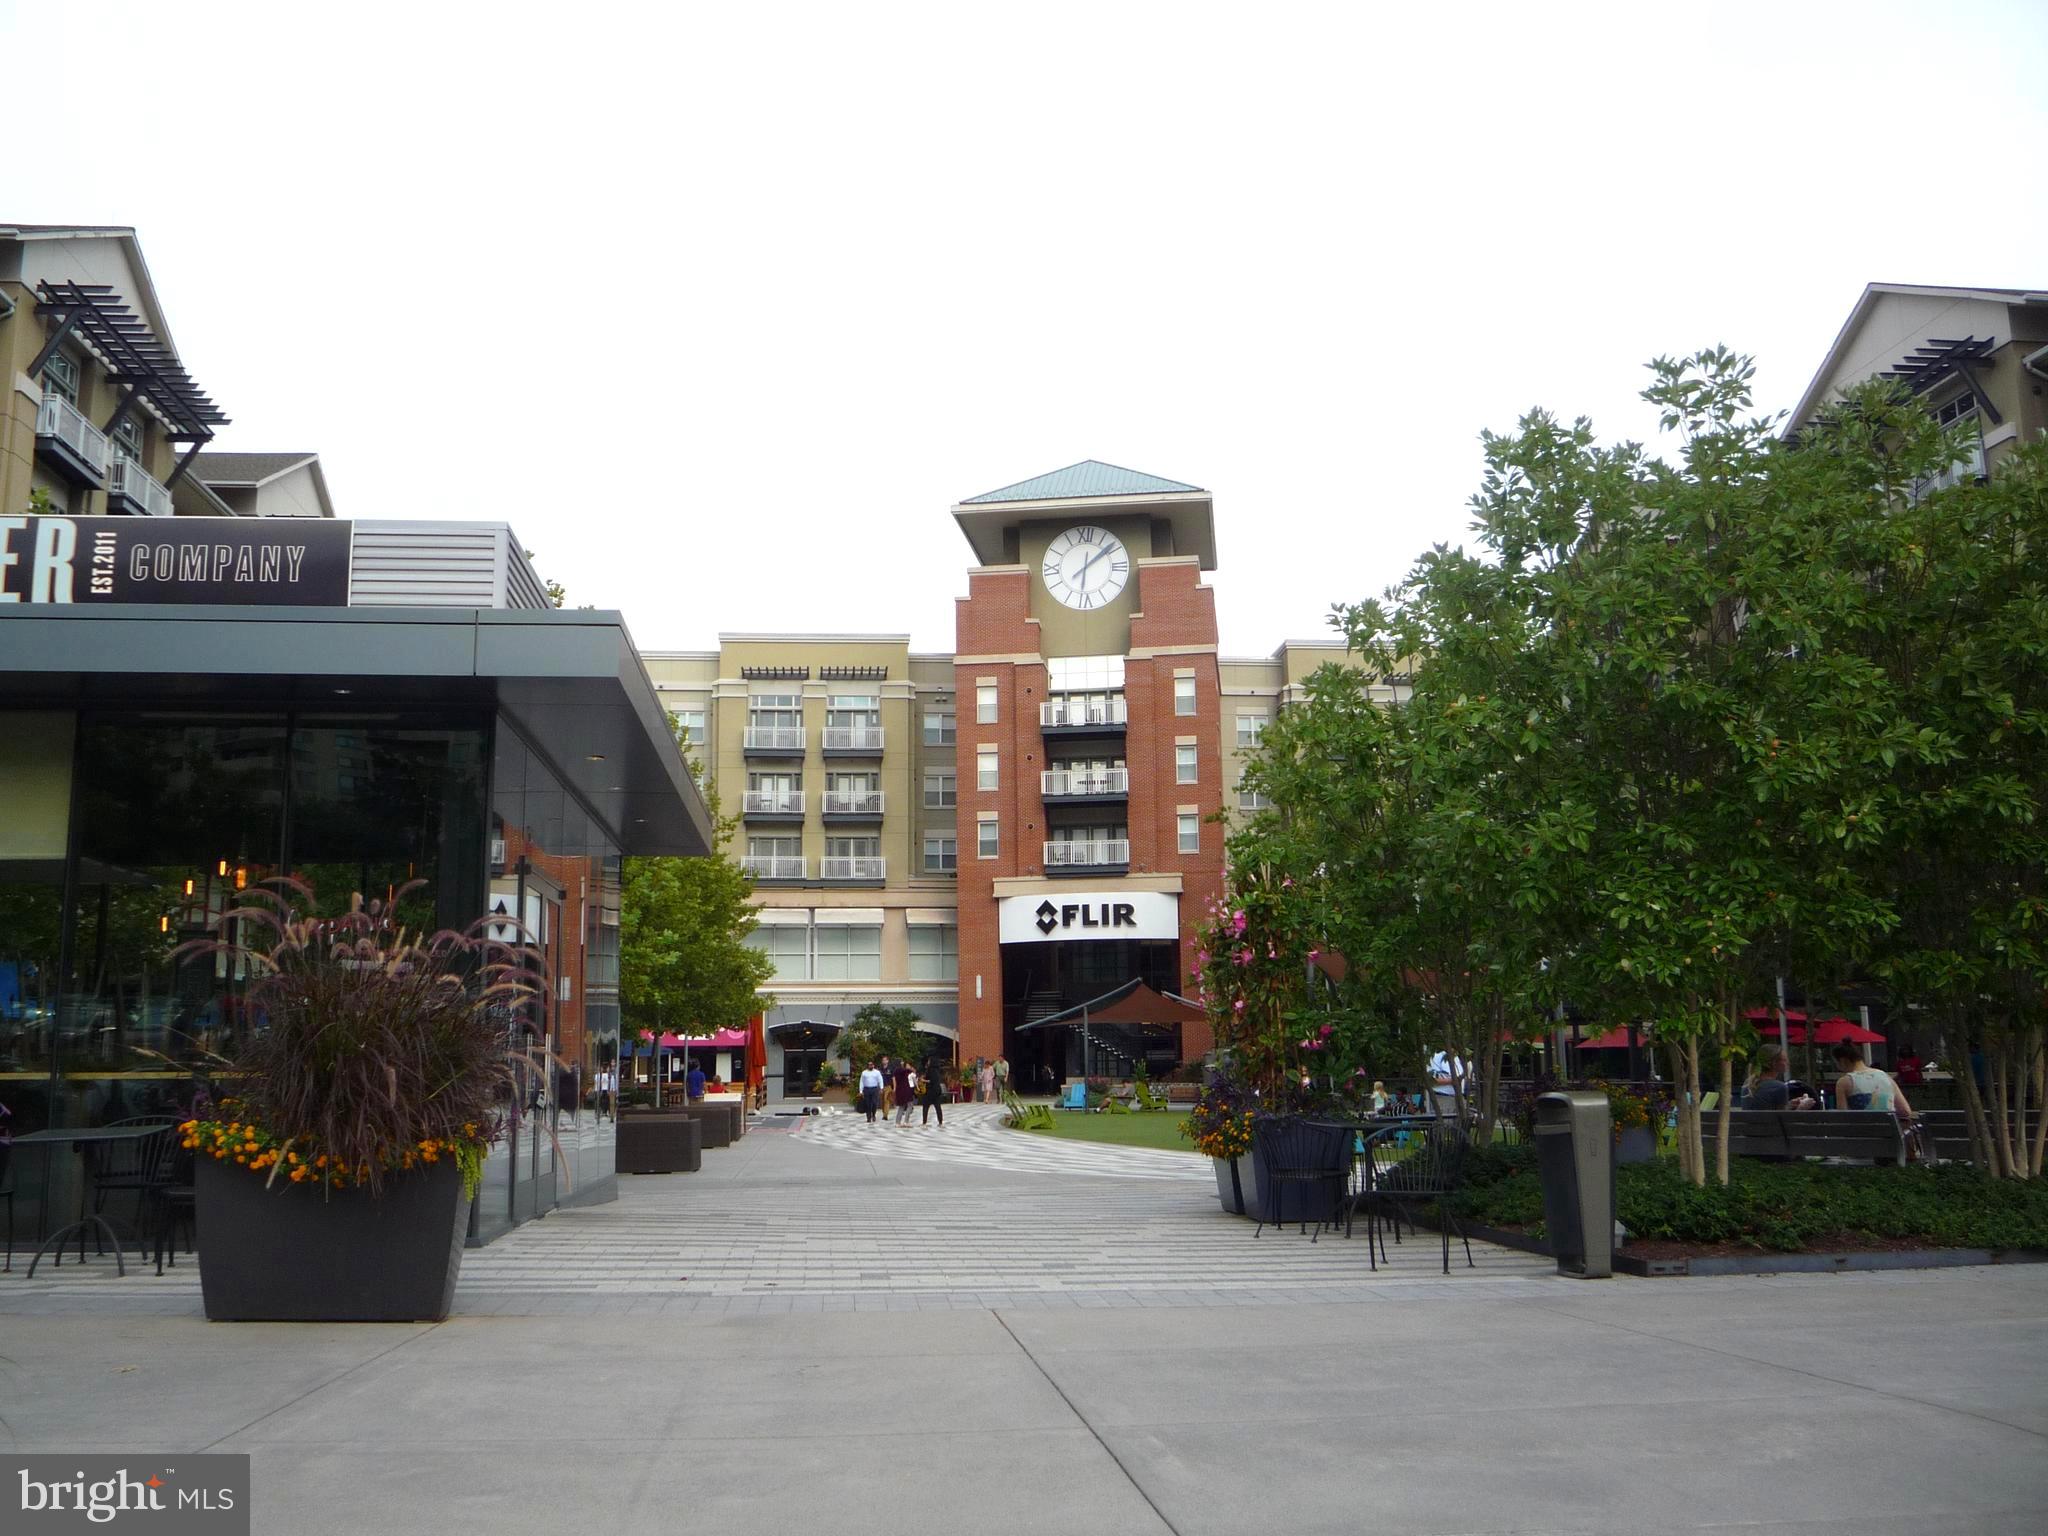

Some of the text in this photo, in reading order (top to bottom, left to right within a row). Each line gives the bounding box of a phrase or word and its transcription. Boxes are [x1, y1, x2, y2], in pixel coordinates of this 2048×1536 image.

[1077, 528, 1095, 543] XII
[90, 531, 117, 594] EST.2011
[129, 543, 306, 583] COMPANY
[1061, 903, 1137, 928] FLIR
